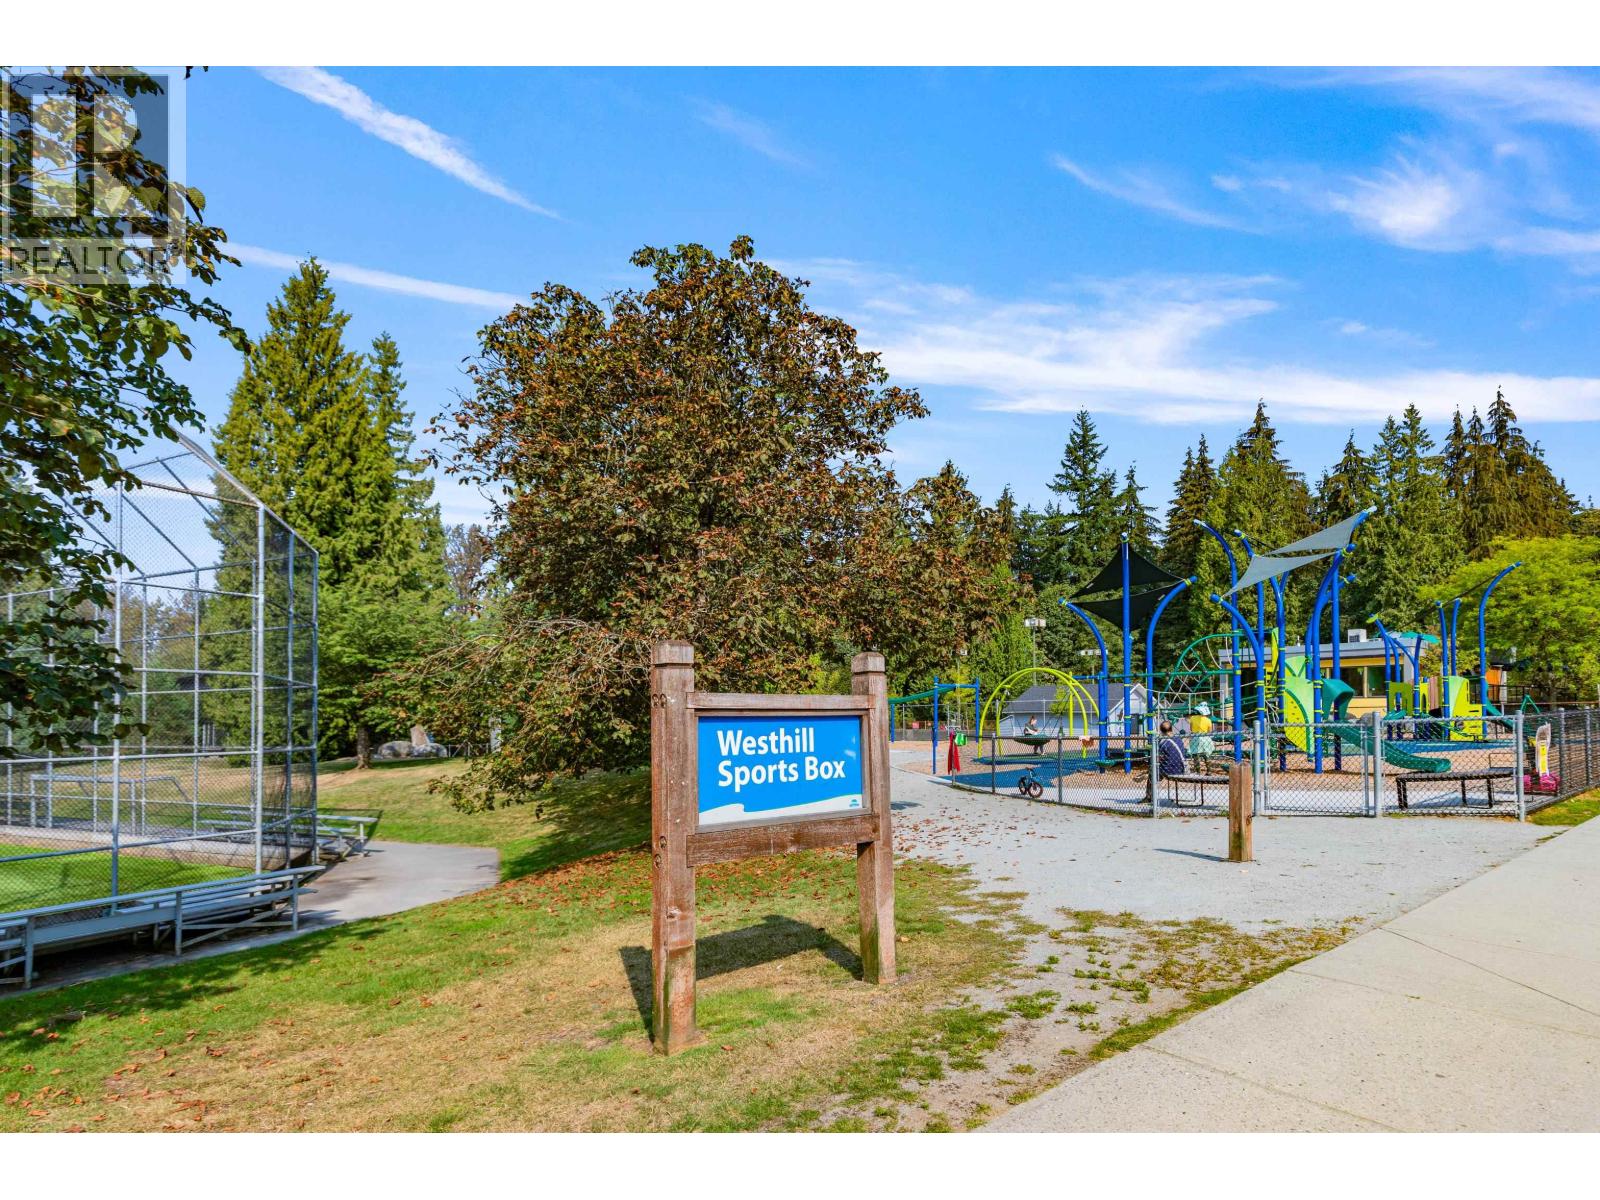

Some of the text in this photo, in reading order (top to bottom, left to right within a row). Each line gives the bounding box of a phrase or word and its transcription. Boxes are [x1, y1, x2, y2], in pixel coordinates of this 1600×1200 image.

[717, 727, 815, 756] Westhill
[718, 756, 846, 792] Sports Box
